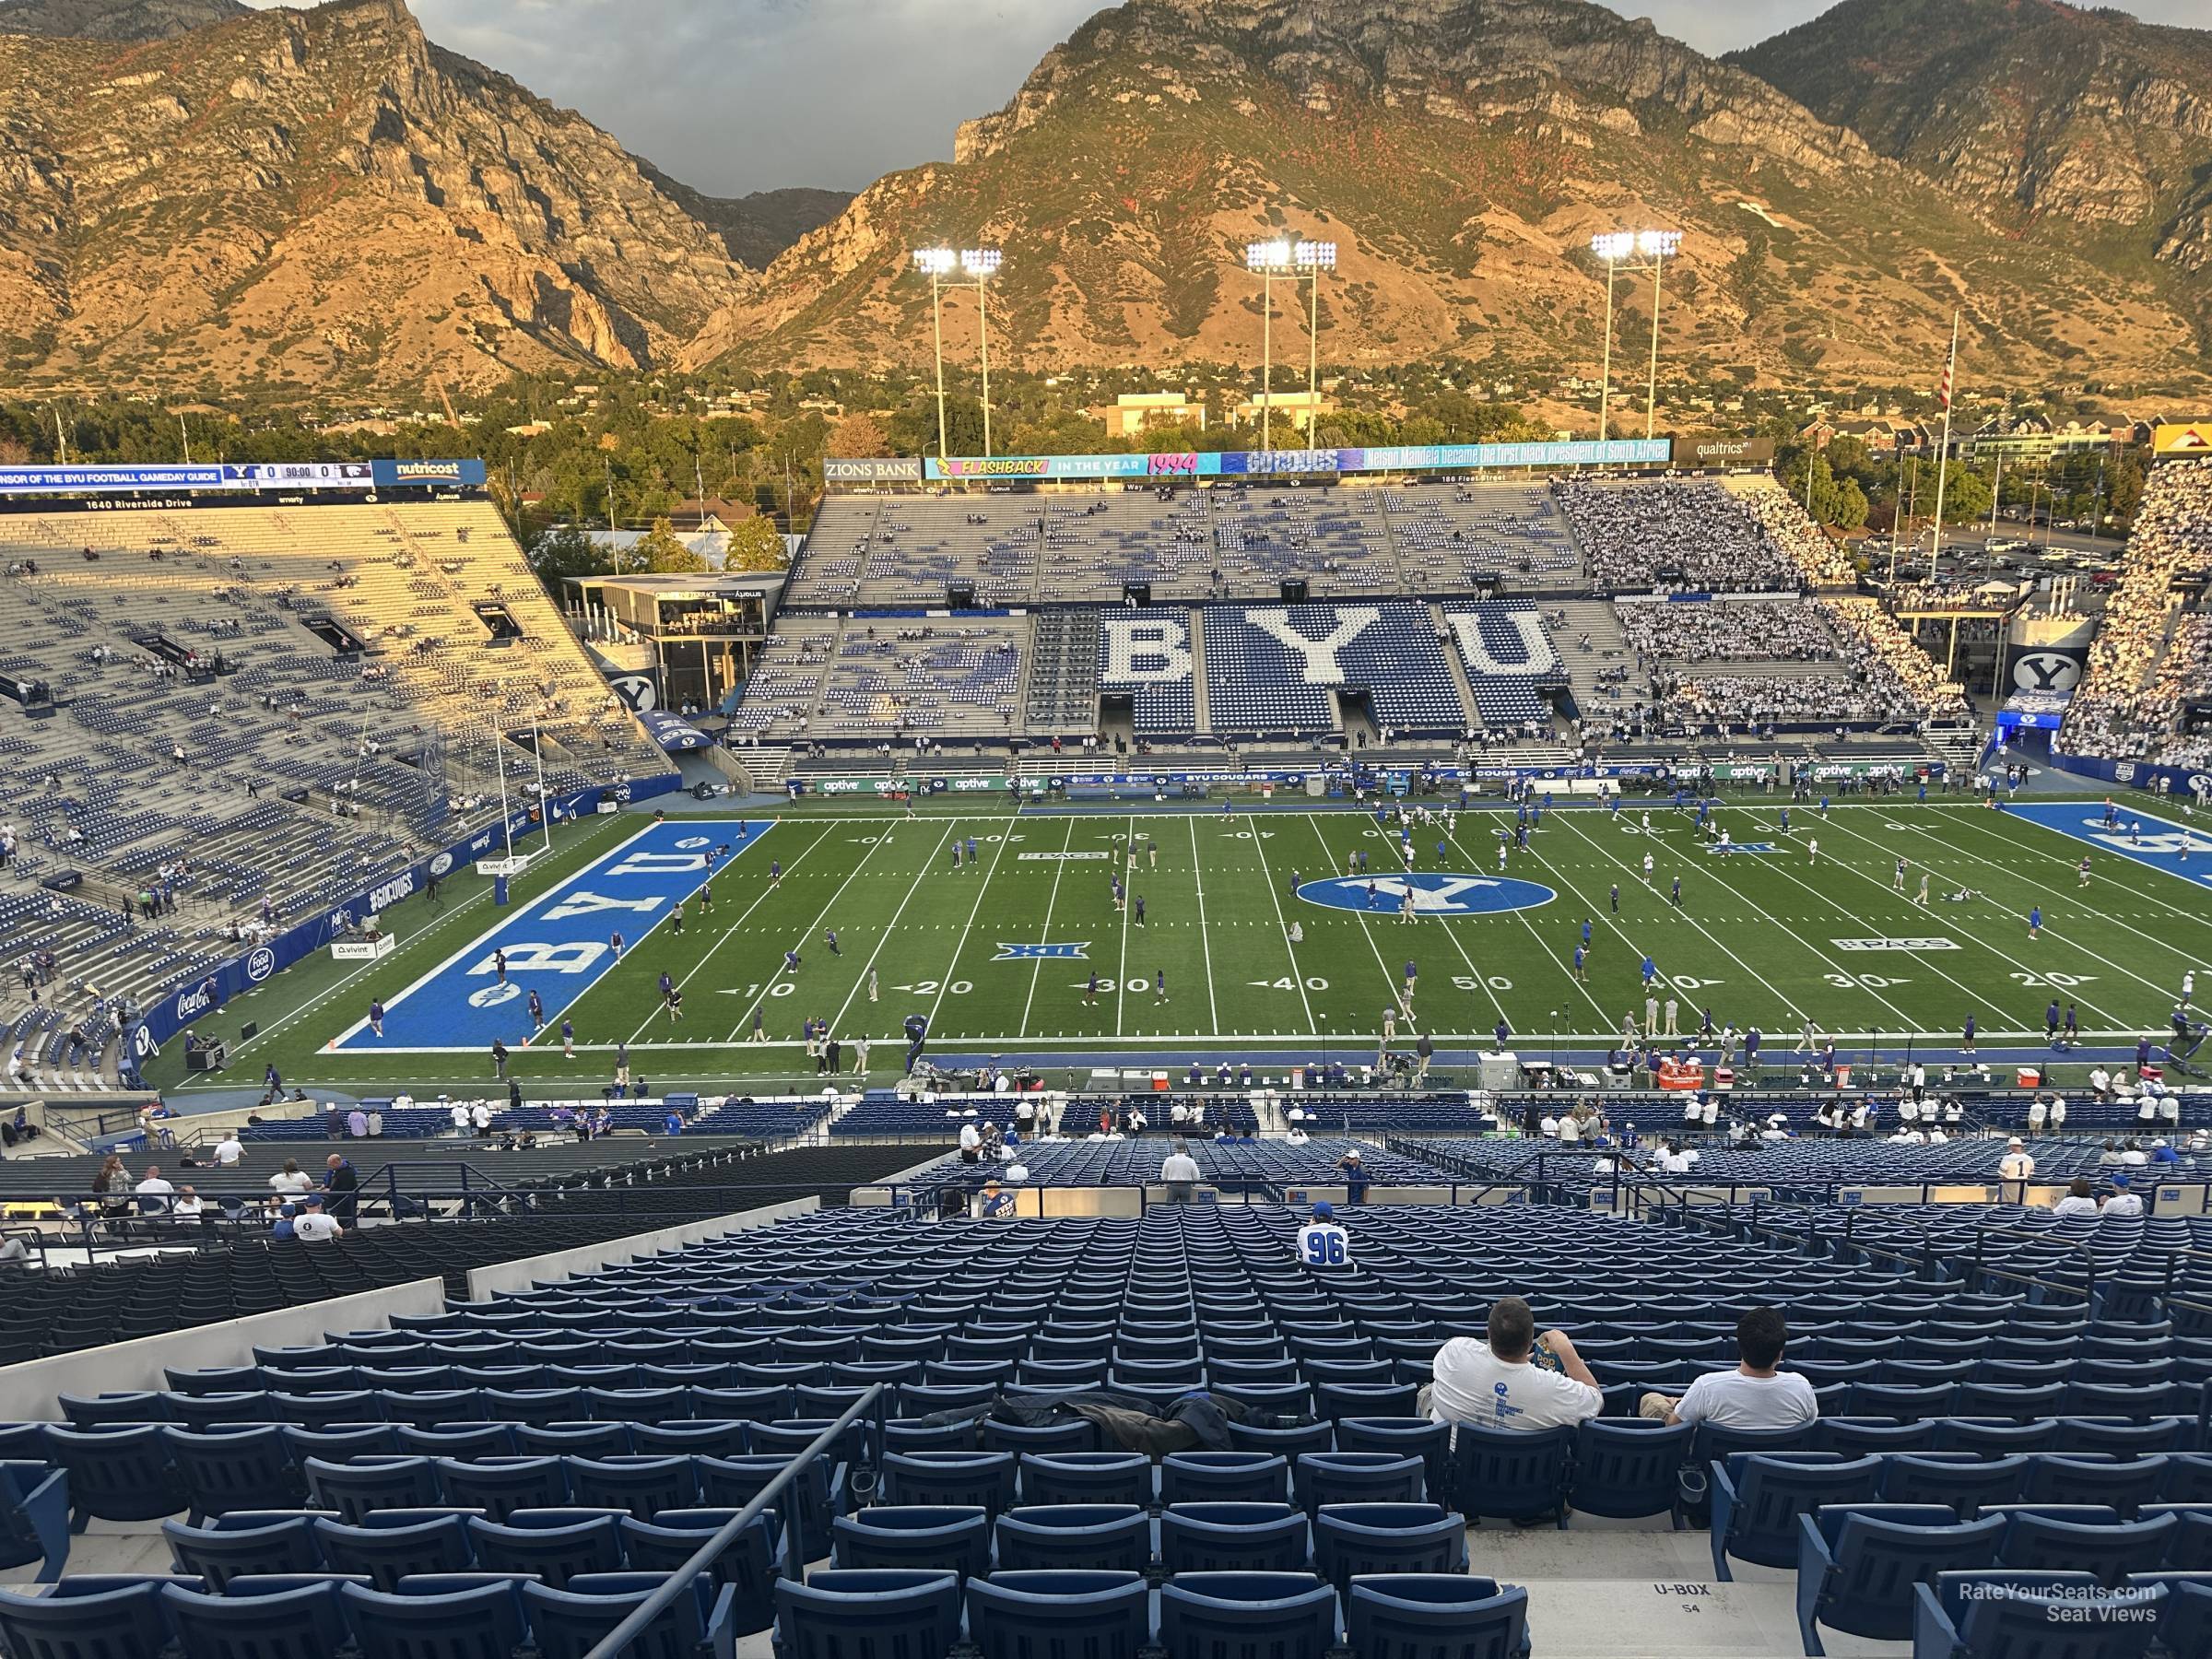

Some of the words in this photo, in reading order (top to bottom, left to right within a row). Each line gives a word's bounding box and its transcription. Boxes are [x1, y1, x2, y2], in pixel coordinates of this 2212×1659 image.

[1368, 448, 1399, 467] Nelson
[1402, 447, 1439, 466] Mandela
[1441, 447, 1477, 465] became
[1481, 446, 1496, 464] the
[1499, 445, 1518, 463] first
[1522, 443, 1546, 462] black
[1548, 441, 1593, 464] president
[1597, 441, 1605, 461] of
[1607, 441, 1634, 460] South
[1637, 440, 1666, 459] Africa
[1697, 441, 1742, 455] qualtrics
[267, 465, 276, 477] 0
[286, 466, 311, 477] 90:00
[321, 465, 329, 477] 0
[396, 462, 459, 475] nutricost
[826, 463, 872, 477] ZIONS
[876, 463, 919, 477] BANK
[961, 460, 1042, 475] FLASHBACK
[1058, 462, 1071, 471] IN
[1076, 461, 1100, 471] THE
[1104, 460, 1138, 471] YEAR
[1147, 453, 1197, 476] 1994
[29, 475, 42, 484] OF
[45, 474, 64, 484] THE
[65, 474, 85, 483] BYU
[87, 473, 138, 483] FOOTBALL
[140, 472, 185, 482] GAMEDAY
[187, 472, 217, 481] GUIDE
[1127, 483, 1144, 492] Way
[87, 500, 112, 509] 1640
[115, 500, 162, 509] Riverside
[166, 499, 192, 508] Drive
[278, 496, 304, 504] smarty
[1105, 606, 1556, 683] BYU
[1816, 763, 1853, 776] aptive
[1212, 773, 1268, 782] COUGARS
[824, 780, 859, 791] aptive
[955, 779, 990, 790] aptive
[530, 809, 540, 823] 40
[861, 836, 894, 844] 10
[1112, 832, 1150, 841] 30
[370, 872, 413, 912] #GOCOUGS
[347, 946, 368, 954] vivint
[1861, 939, 1952, 948] PACS
[252, 951, 268, 971] Food
[1094, 978, 1149, 993] 30
[1272, 977, 1329, 991] 40
[1451, 976, 1513, 990] 50
[1822, 973, 1889, 988] 30
[2008, 972, 2080, 986] 20
[744, 982, 795, 998] 10
[912, 981, 973, 994] 20
[2018, 1160, 2025, 1177] 1
[1307, 1231, 1345, 1265] 96
[1653, 1583, 1711, 1595] U-BOX
